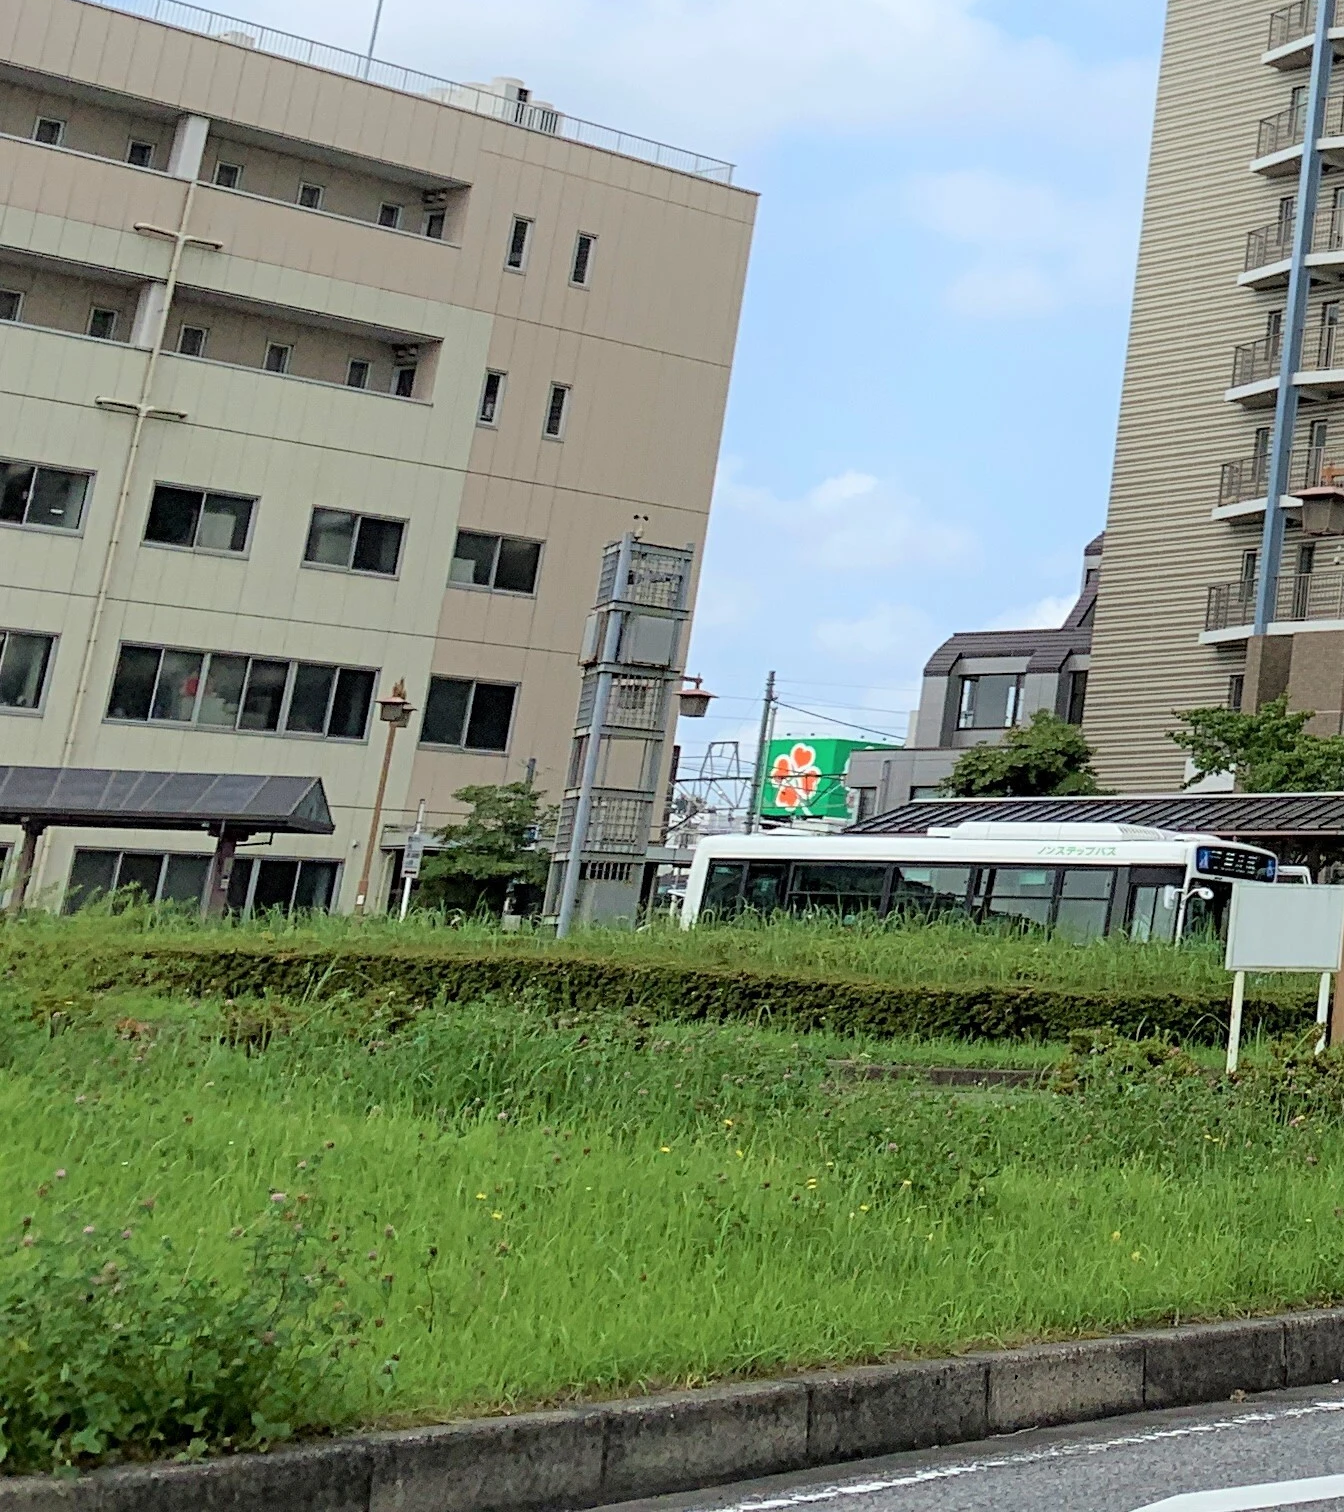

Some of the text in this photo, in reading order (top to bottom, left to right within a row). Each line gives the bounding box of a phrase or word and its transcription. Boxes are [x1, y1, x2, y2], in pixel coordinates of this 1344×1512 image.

[1038, 846, 1117, 856] ノンステップバス
